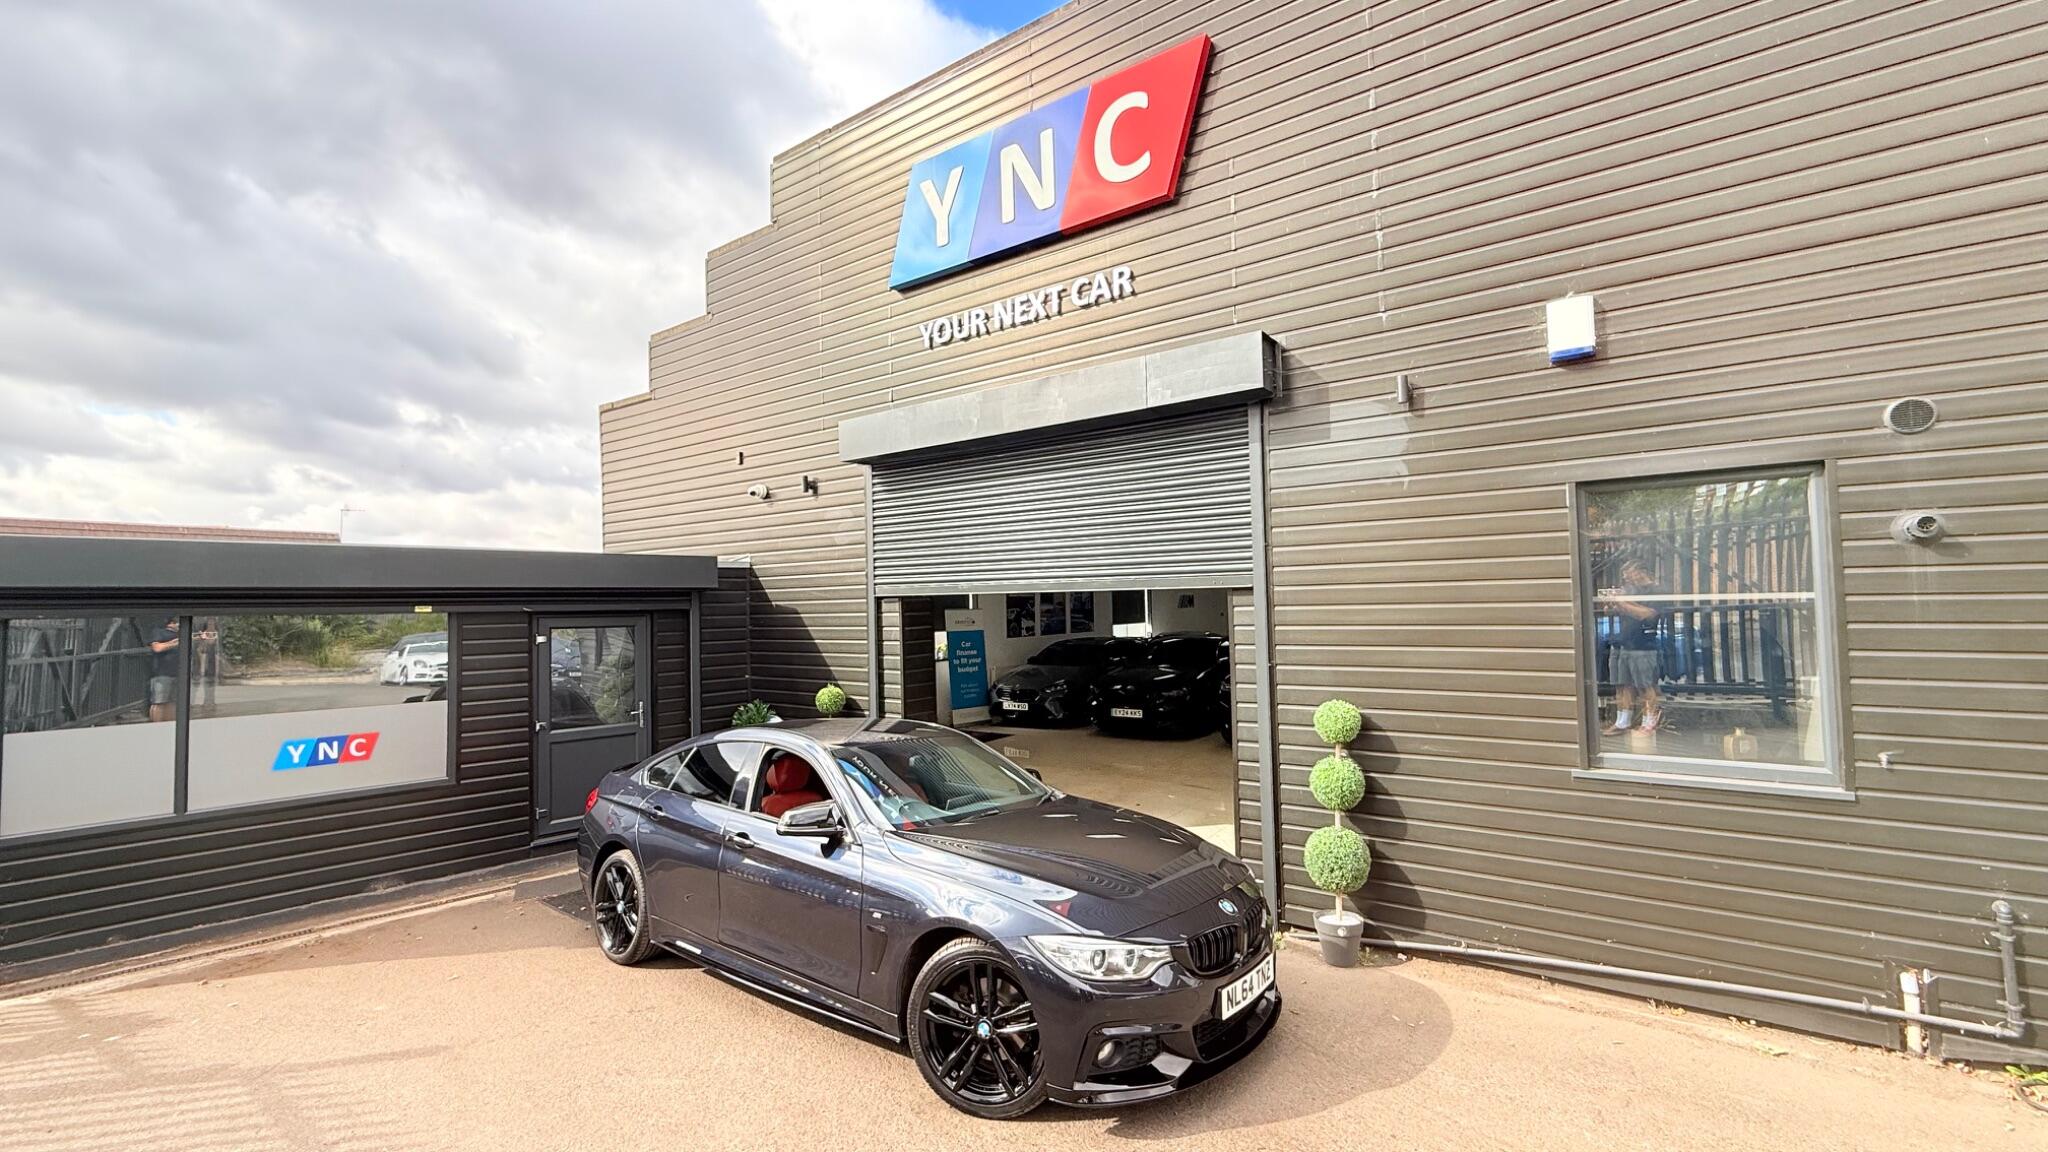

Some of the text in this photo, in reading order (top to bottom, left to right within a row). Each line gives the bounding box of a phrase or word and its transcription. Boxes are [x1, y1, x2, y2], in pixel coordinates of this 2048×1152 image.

[919, 91, 1151, 247] YNC
[919, 265, 1136, 348] YOUR NEXT CAR
[957, 665, 978, 673] budget
[968, 657, 982, 665] your
[287, 738, 367, 763] YNC
[1227, 974, 1254, 1011] NL64
